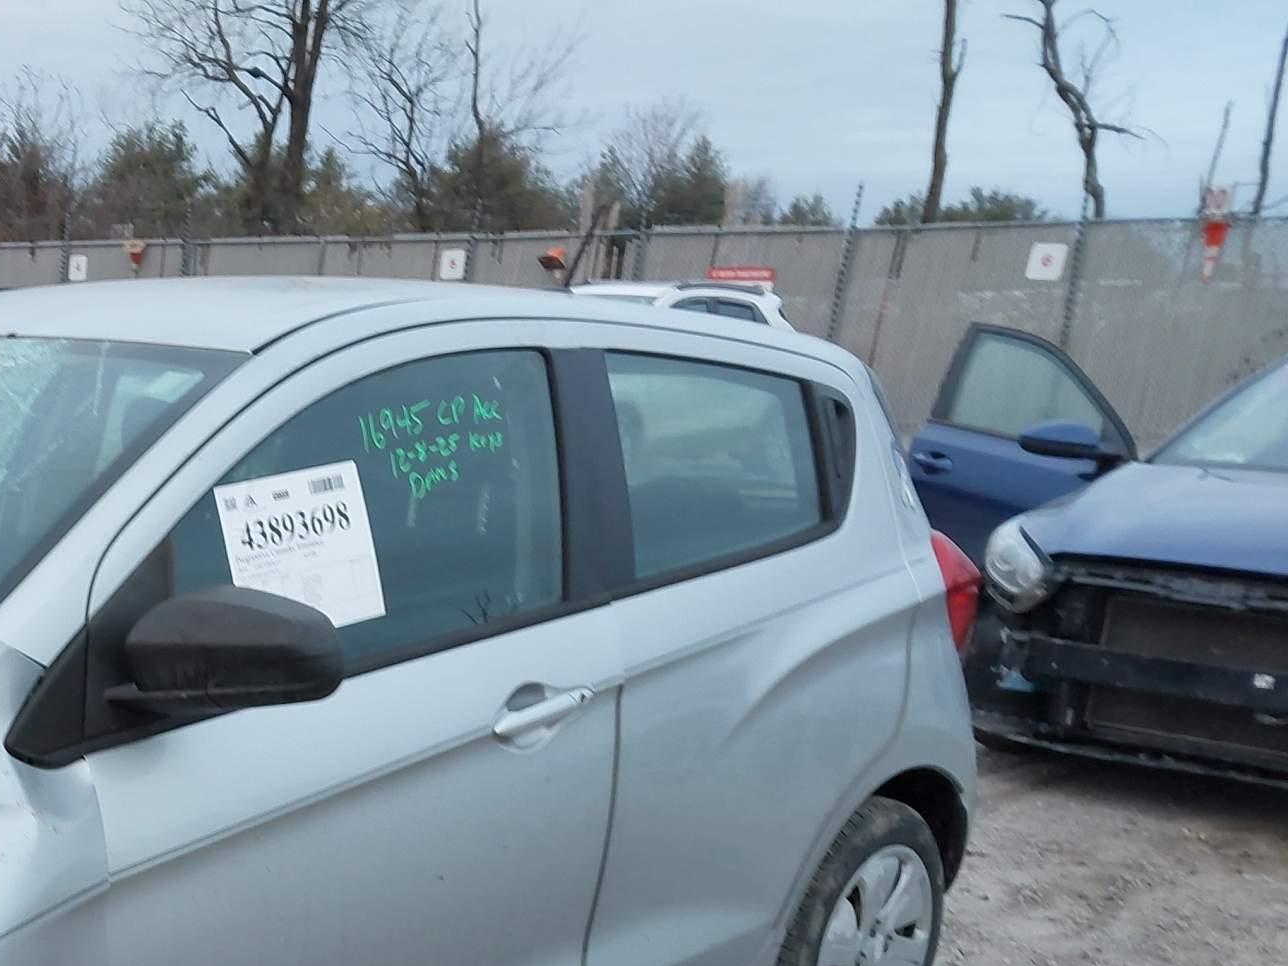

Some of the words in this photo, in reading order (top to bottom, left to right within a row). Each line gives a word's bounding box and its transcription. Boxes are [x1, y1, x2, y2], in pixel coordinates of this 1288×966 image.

[358, 399, 431, 453] 16945
[390, 433, 460, 479] 12-8-25
[241, 500, 351, 551] 43893698
